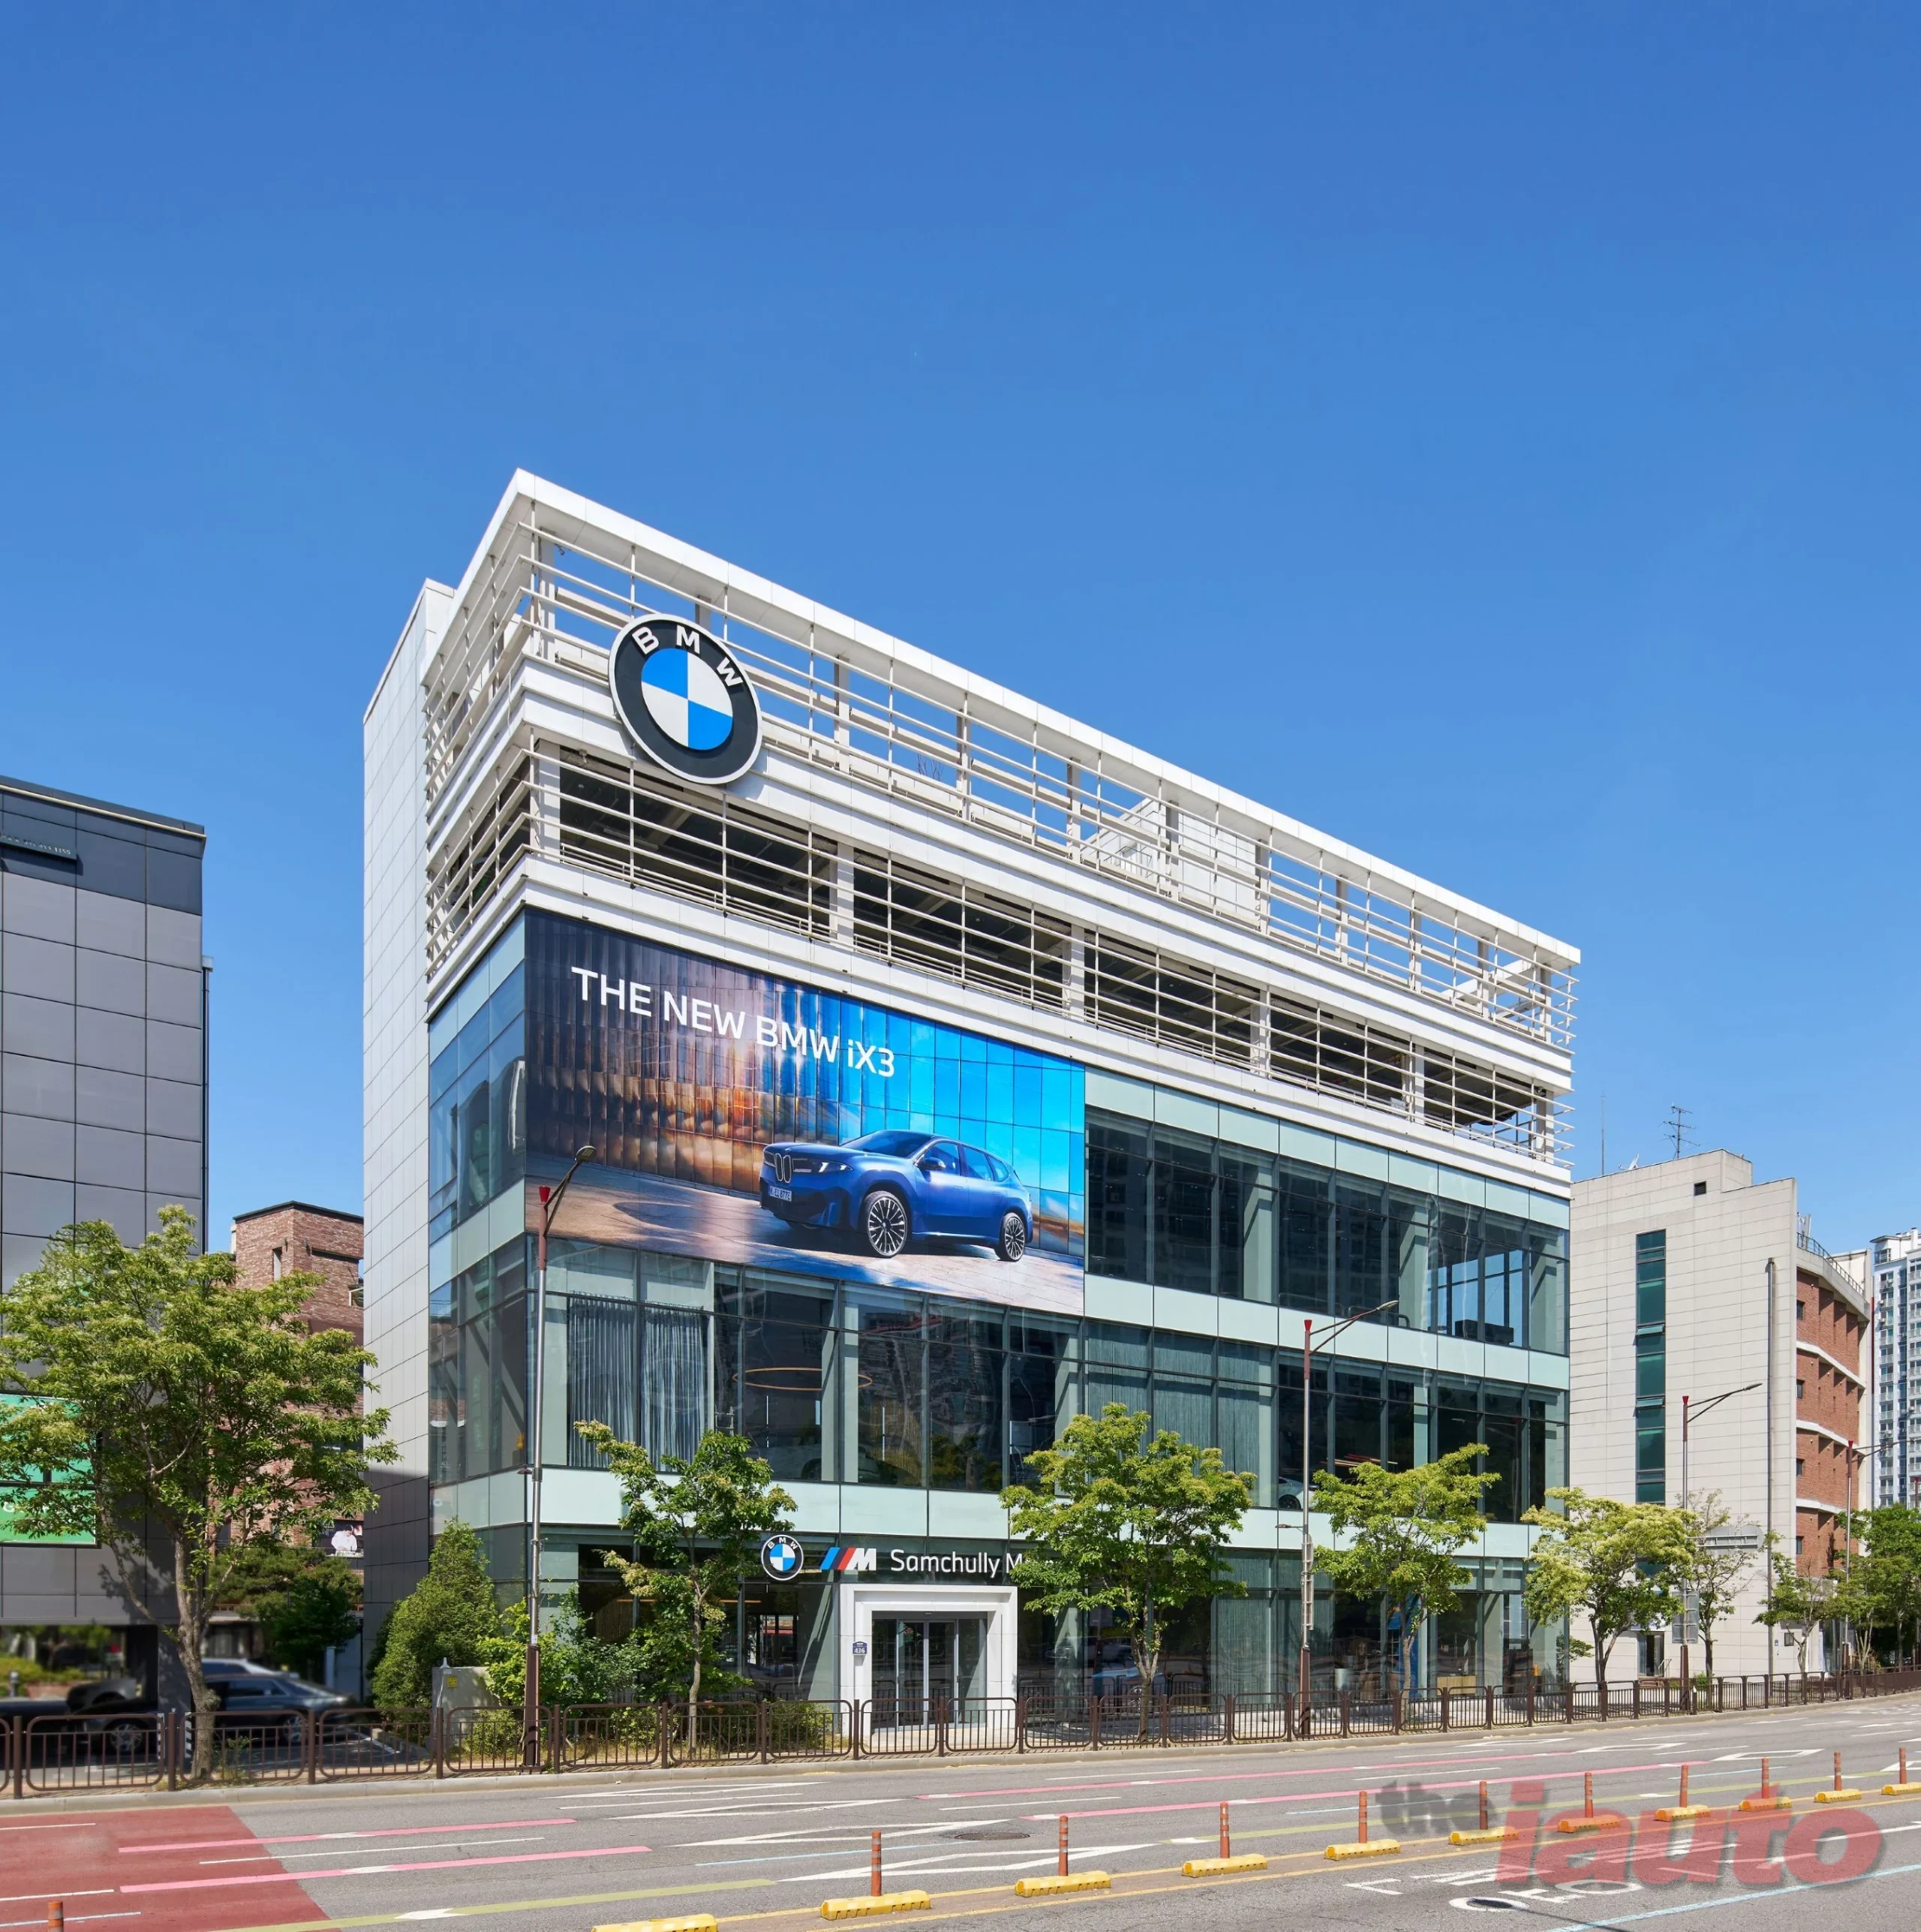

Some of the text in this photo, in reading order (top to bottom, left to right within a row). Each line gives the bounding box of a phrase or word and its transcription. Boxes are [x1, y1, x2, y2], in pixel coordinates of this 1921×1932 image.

[632, 624, 744, 687] BMW
[571, 966, 894, 1077] THE NEW BMW iX3
[767, 1537, 798, 1549] BMW
[843, 1548, 876, 1571] M
[891, 1549, 1000, 1578] Samchully
